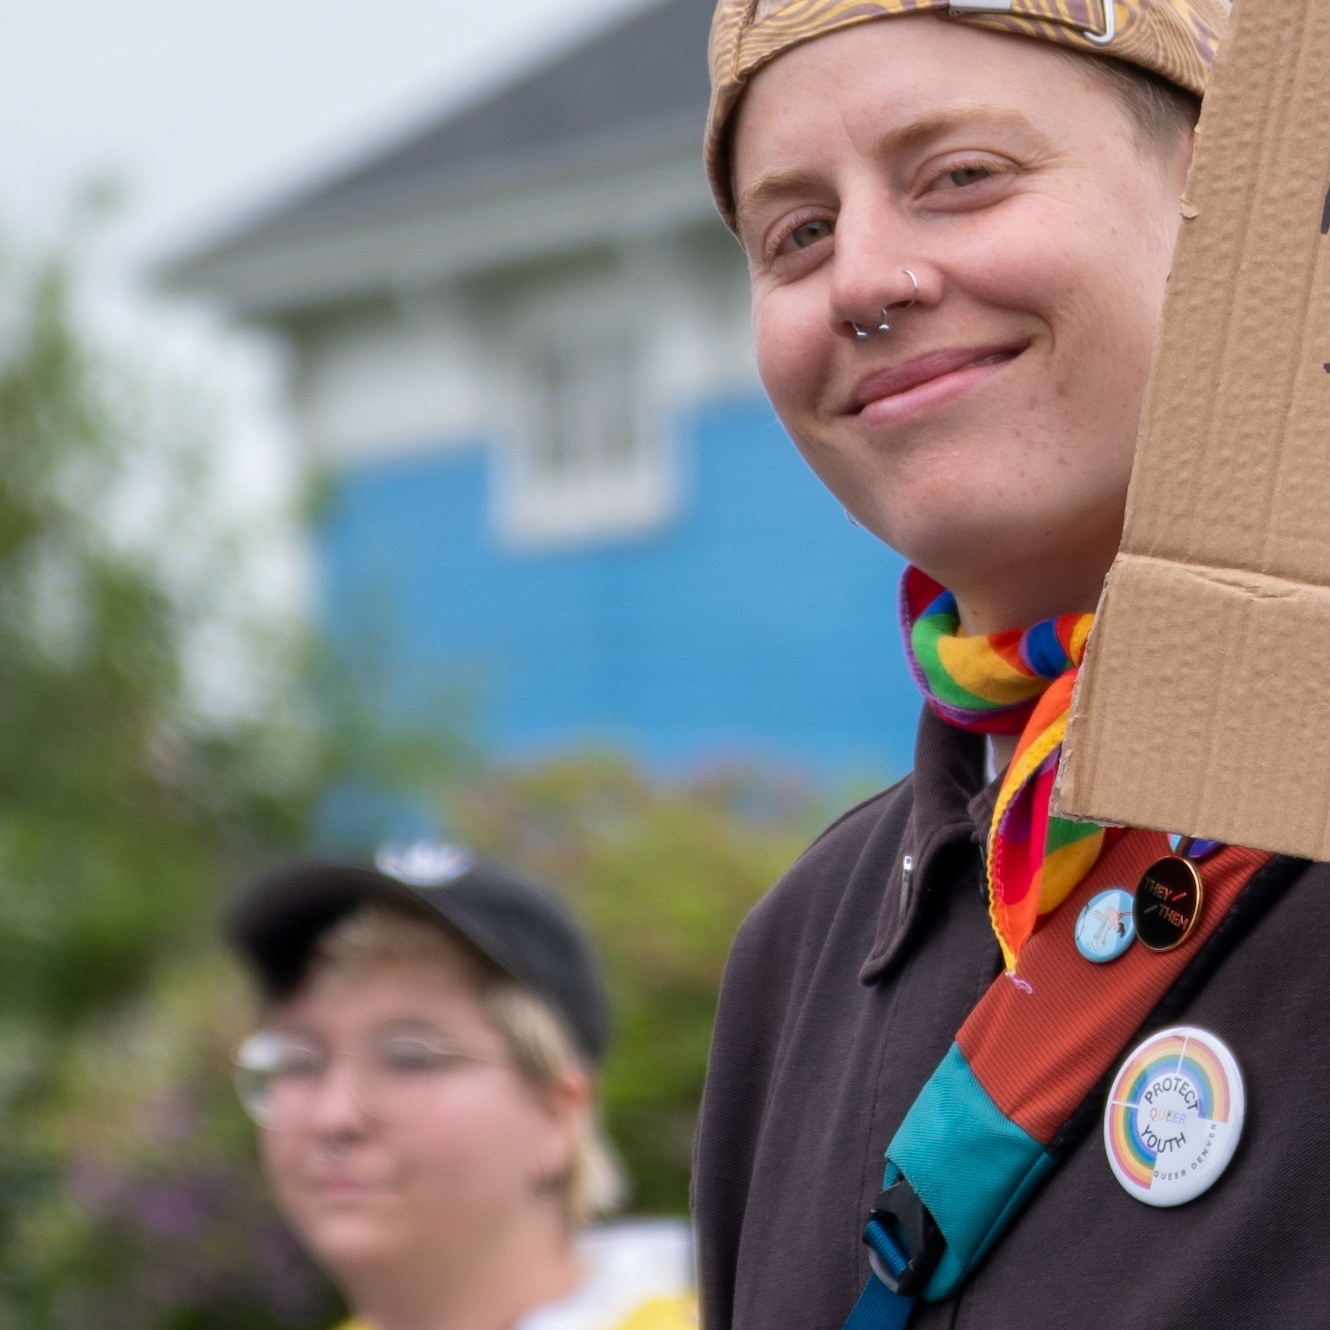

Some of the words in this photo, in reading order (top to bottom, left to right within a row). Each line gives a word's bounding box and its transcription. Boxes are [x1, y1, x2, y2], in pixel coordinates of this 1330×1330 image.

[1144, 1077, 1199, 1111] PROTECT
[1149, 1107, 1187, 1126] QUEER
[1141, 1124, 1187, 1153] YOUTH
[1153, 1169, 1187, 1181] QUEER
[1190, 1122, 1218, 1170] DENVER
